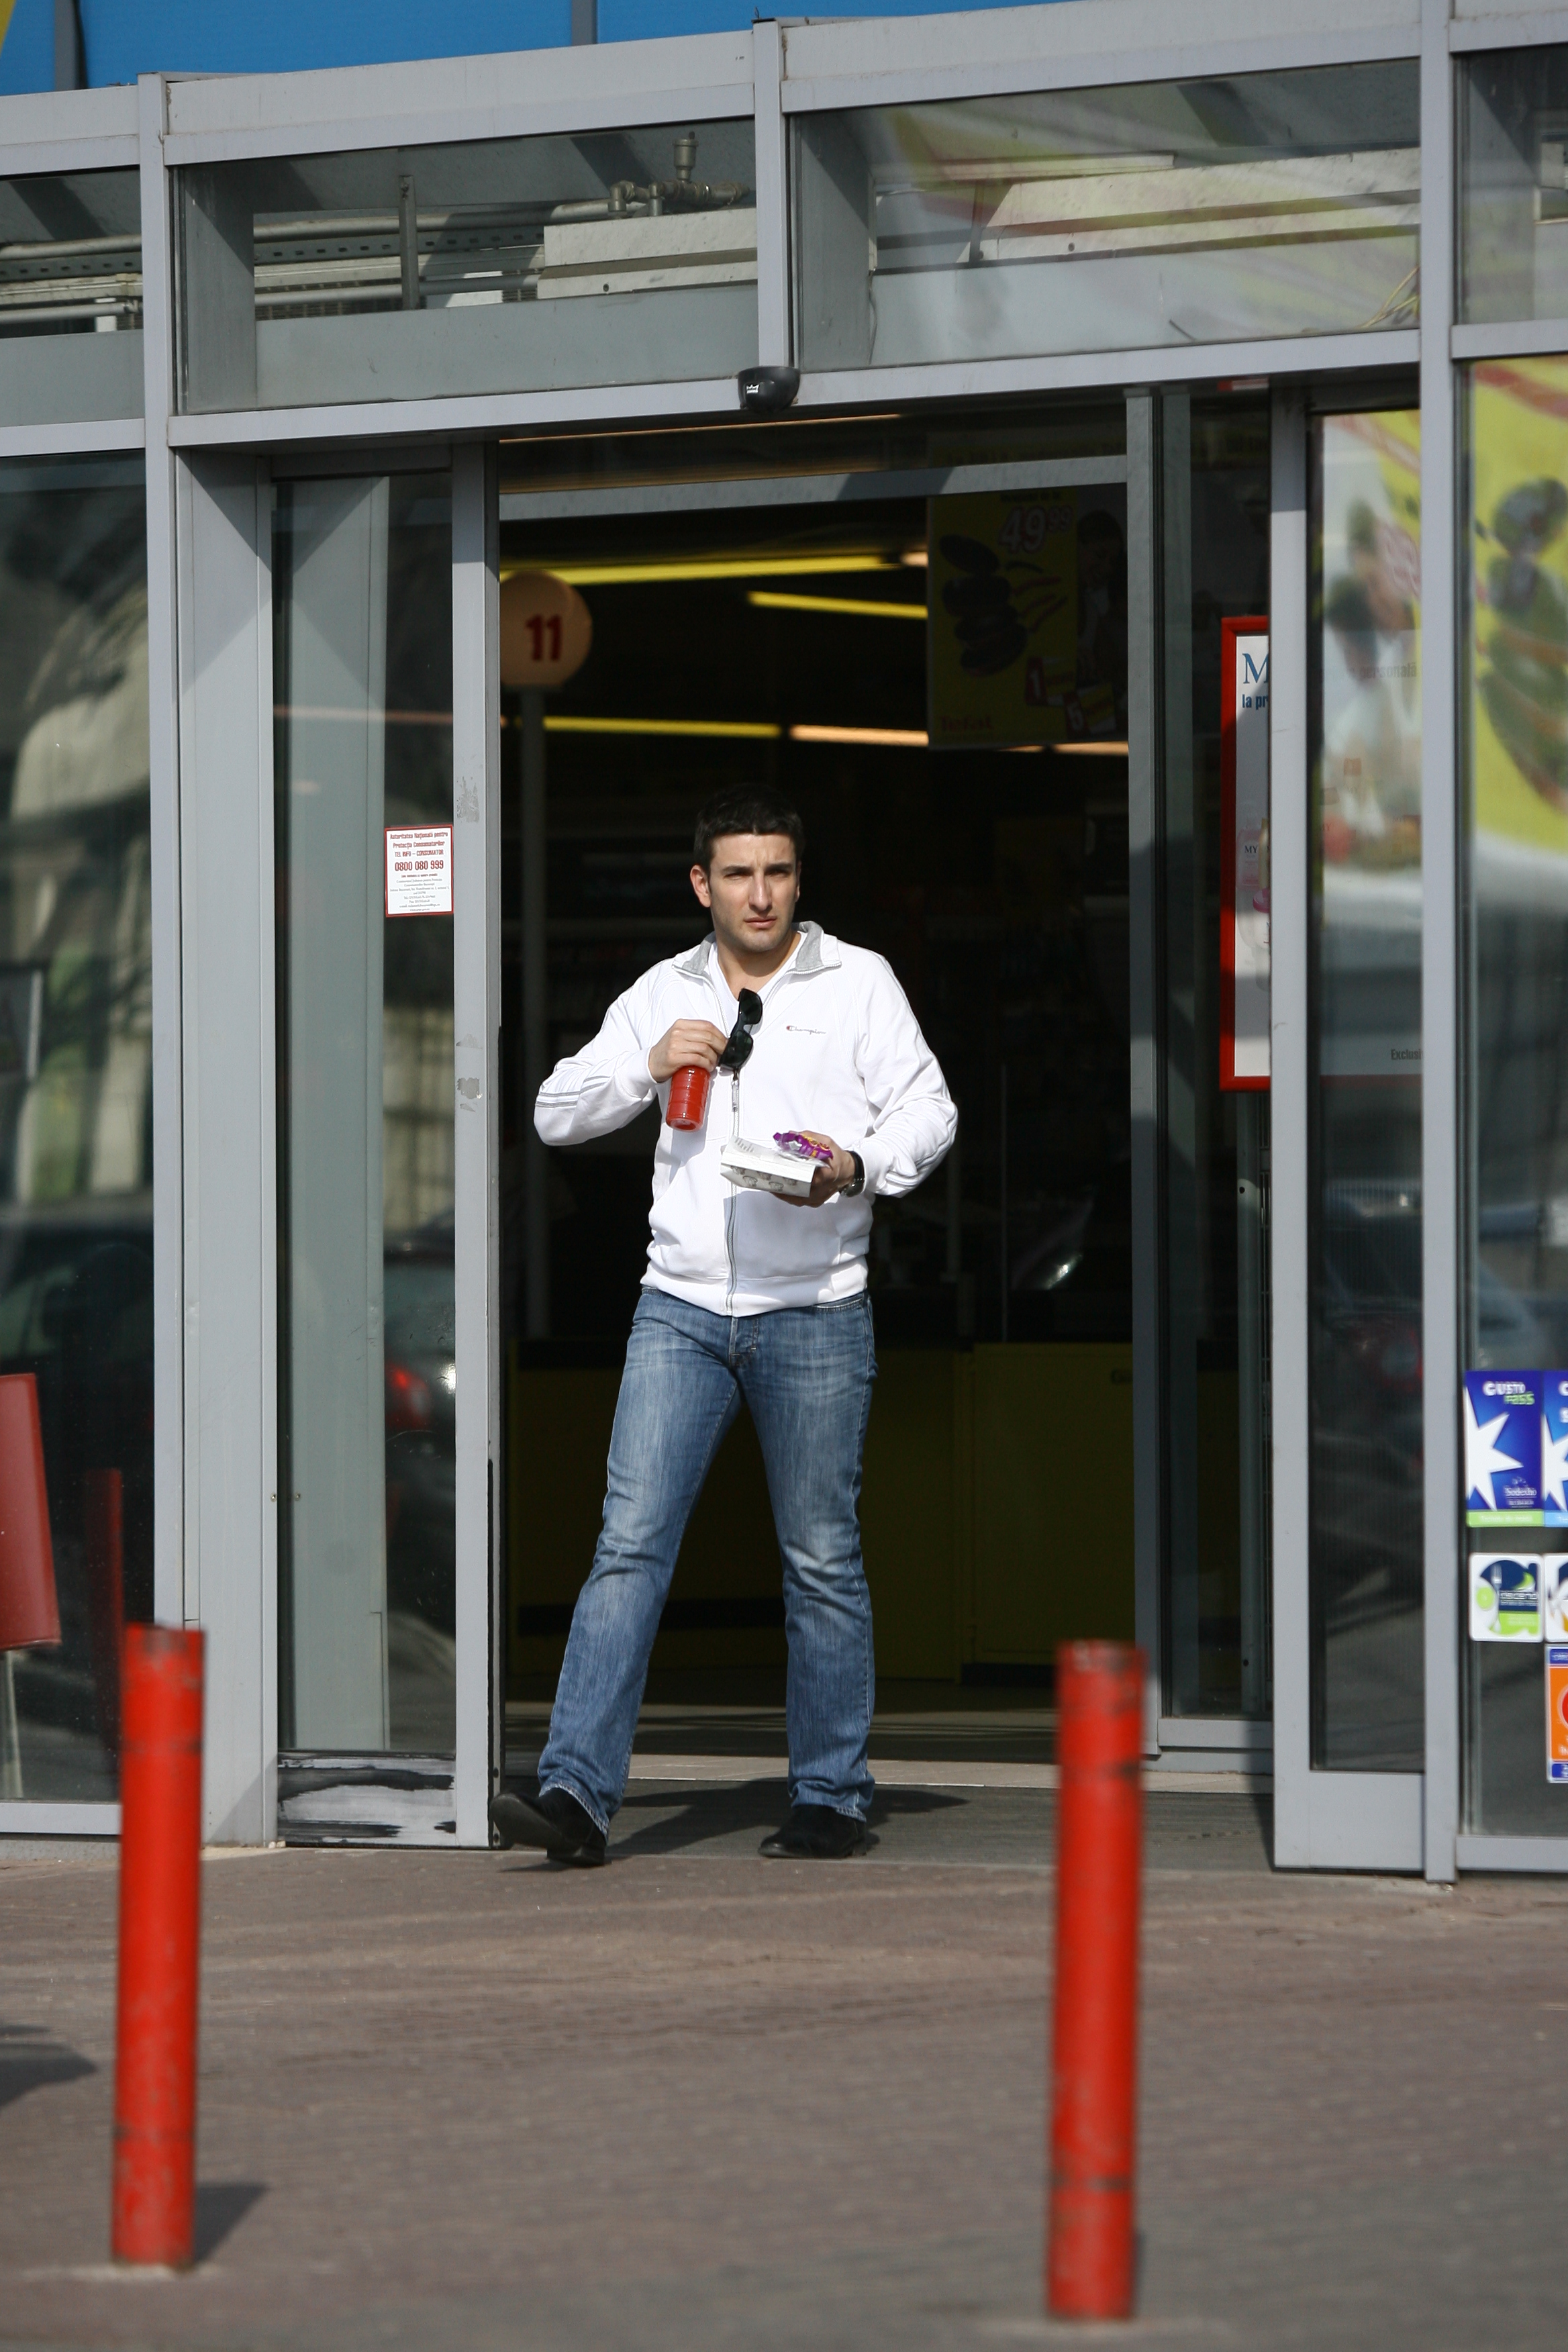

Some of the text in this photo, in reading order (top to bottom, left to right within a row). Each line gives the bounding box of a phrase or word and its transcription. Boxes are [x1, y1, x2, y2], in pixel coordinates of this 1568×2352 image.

[525, 614, 561, 662] 11
[1242, 693, 1252, 708] la
[395, 859, 444, 871] 0800 080 999
[1391, 1048, 1422, 1060] Exclusi
[1483, 1381, 1526, 1396] GUSTO
